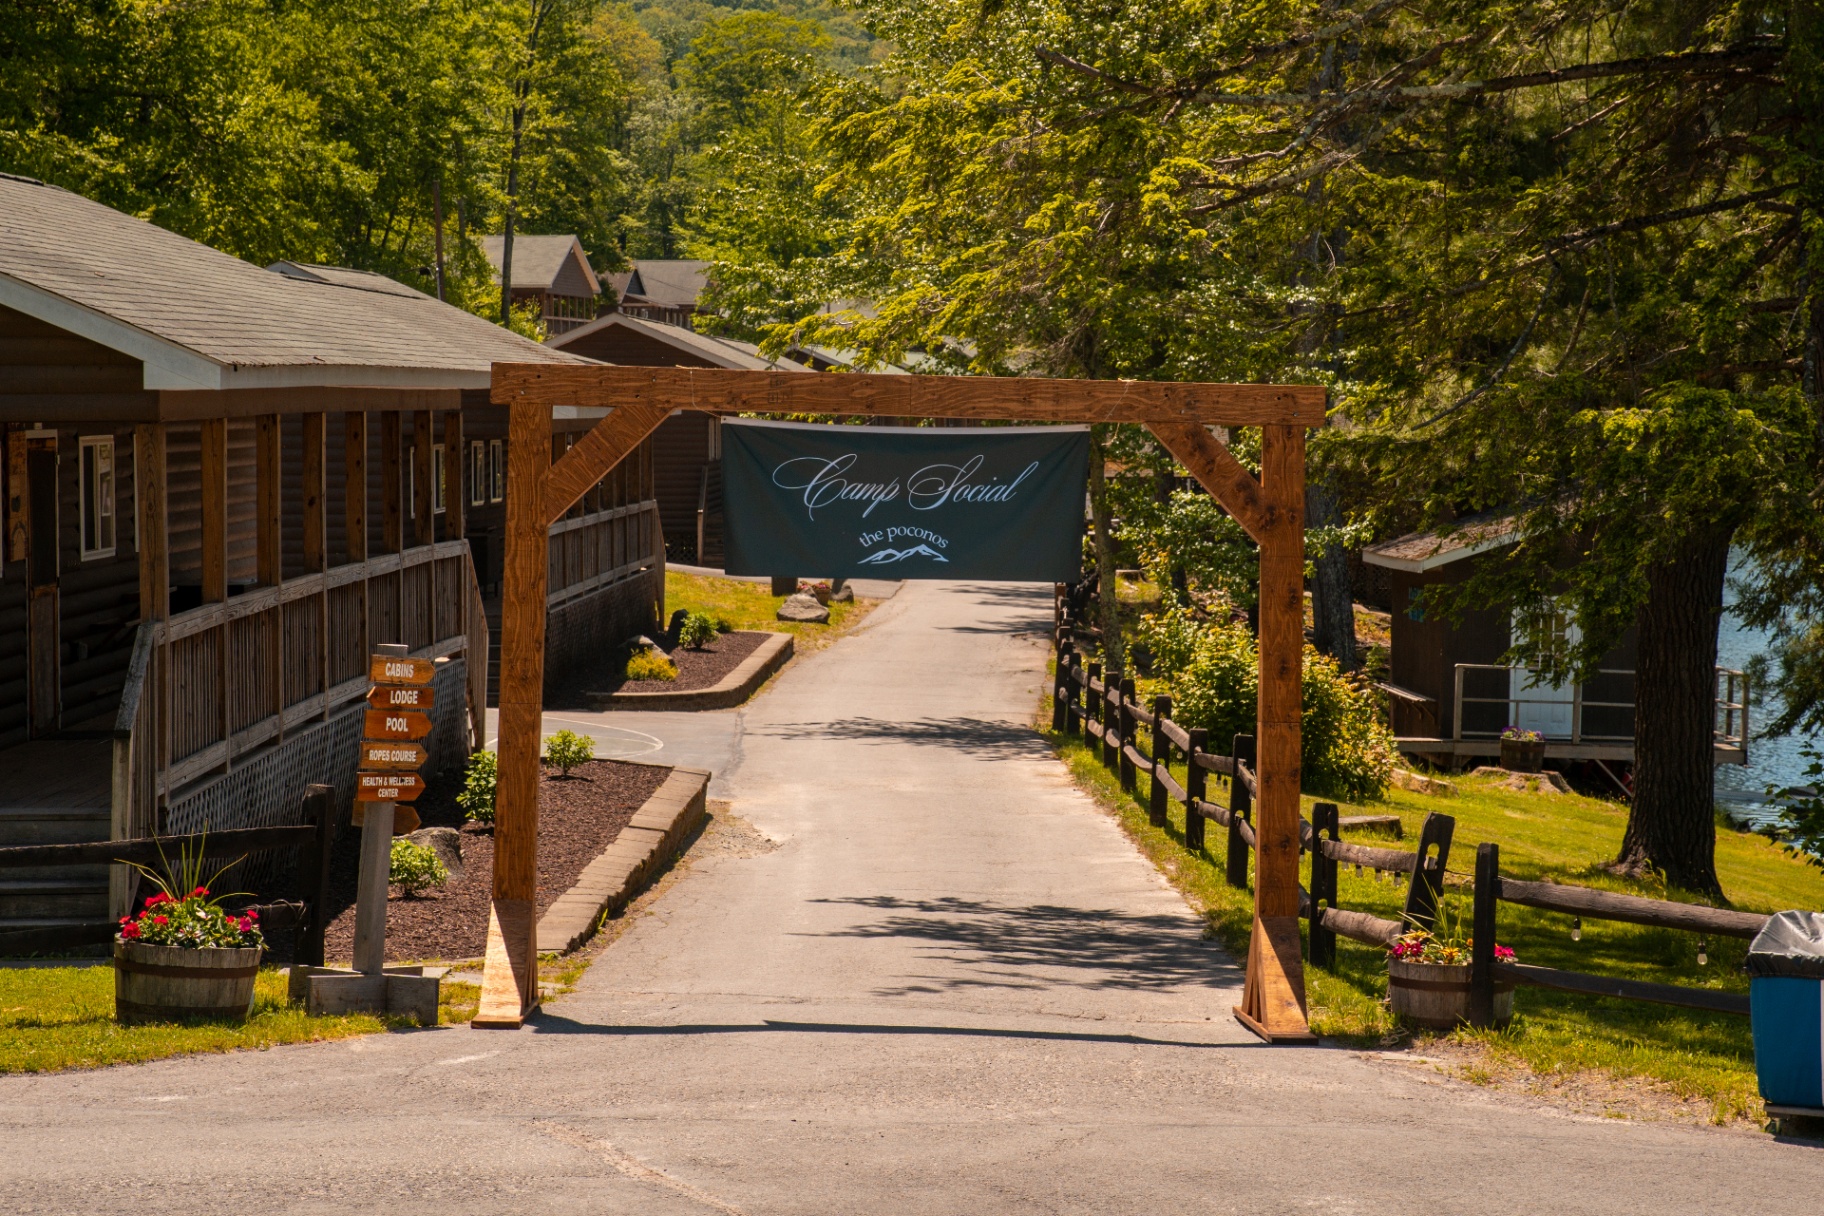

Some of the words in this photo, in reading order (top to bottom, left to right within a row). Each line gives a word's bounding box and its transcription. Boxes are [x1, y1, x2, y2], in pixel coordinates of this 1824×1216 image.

[772, 453, 900, 521] Camp
[907, 454, 1039, 510] Social
[859, 529, 884, 547] the
[886, 526, 949, 548] poconos
[385, 662, 414, 678] CABINS
[390, 690, 418, 704] LODGE
[386, 717, 408, 732] POOL
[369, 749, 390, 762] ROPES
[391, 750, 417, 762] COURSE
[362, 776, 383, 787] HEALTH
[383, 776, 388, 787] &
[378, 788, 399, 798] CENTER
